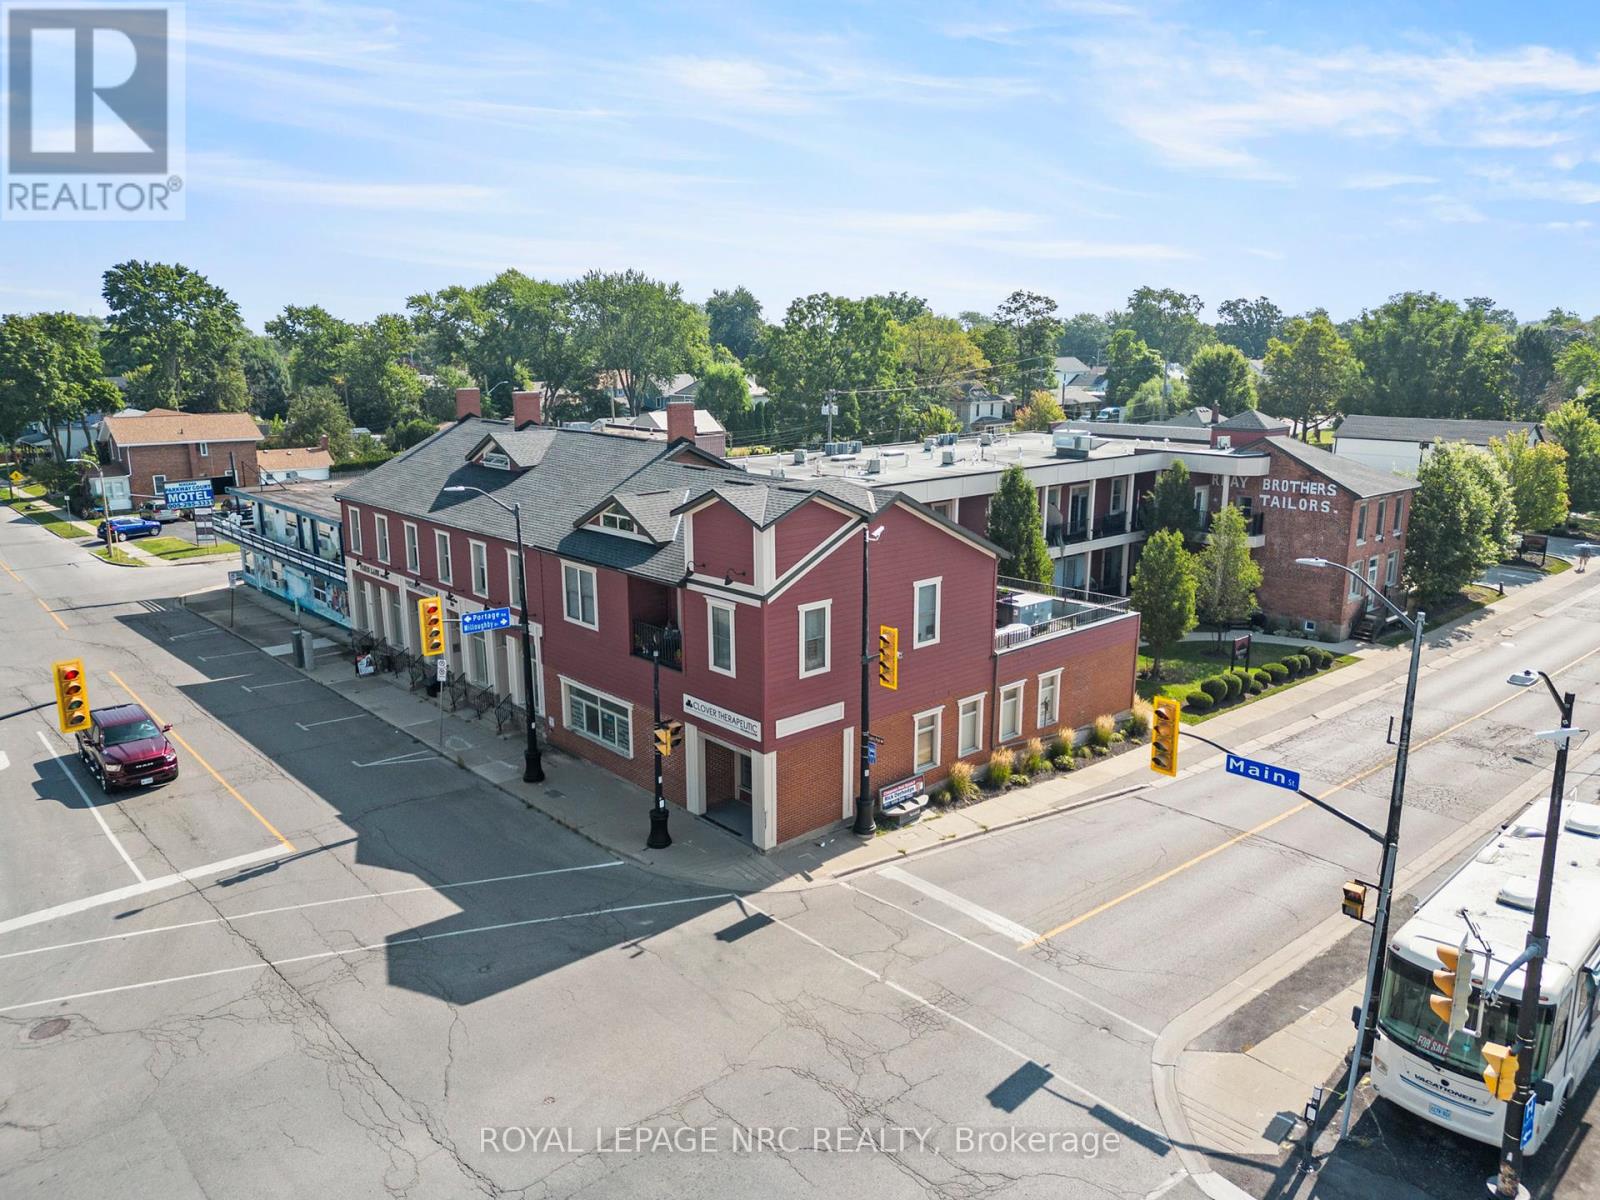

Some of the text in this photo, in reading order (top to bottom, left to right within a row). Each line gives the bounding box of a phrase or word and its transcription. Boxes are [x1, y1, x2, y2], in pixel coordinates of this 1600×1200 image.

[1262, 478, 1337, 496] BROTHERS
[168, 491, 211, 503] MOTEL
[473, 612, 499, 621] Portage
[464, 621, 493, 631] Willoughby
[693, 702, 717, 717] CLOVER
[717, 709, 758, 734] THERAPEUTIC
[1229, 757, 1286, 784] Main
[1417, 1035, 1431, 1049] FOR
[1414, 1073, 1477, 1103] VACATIONER
